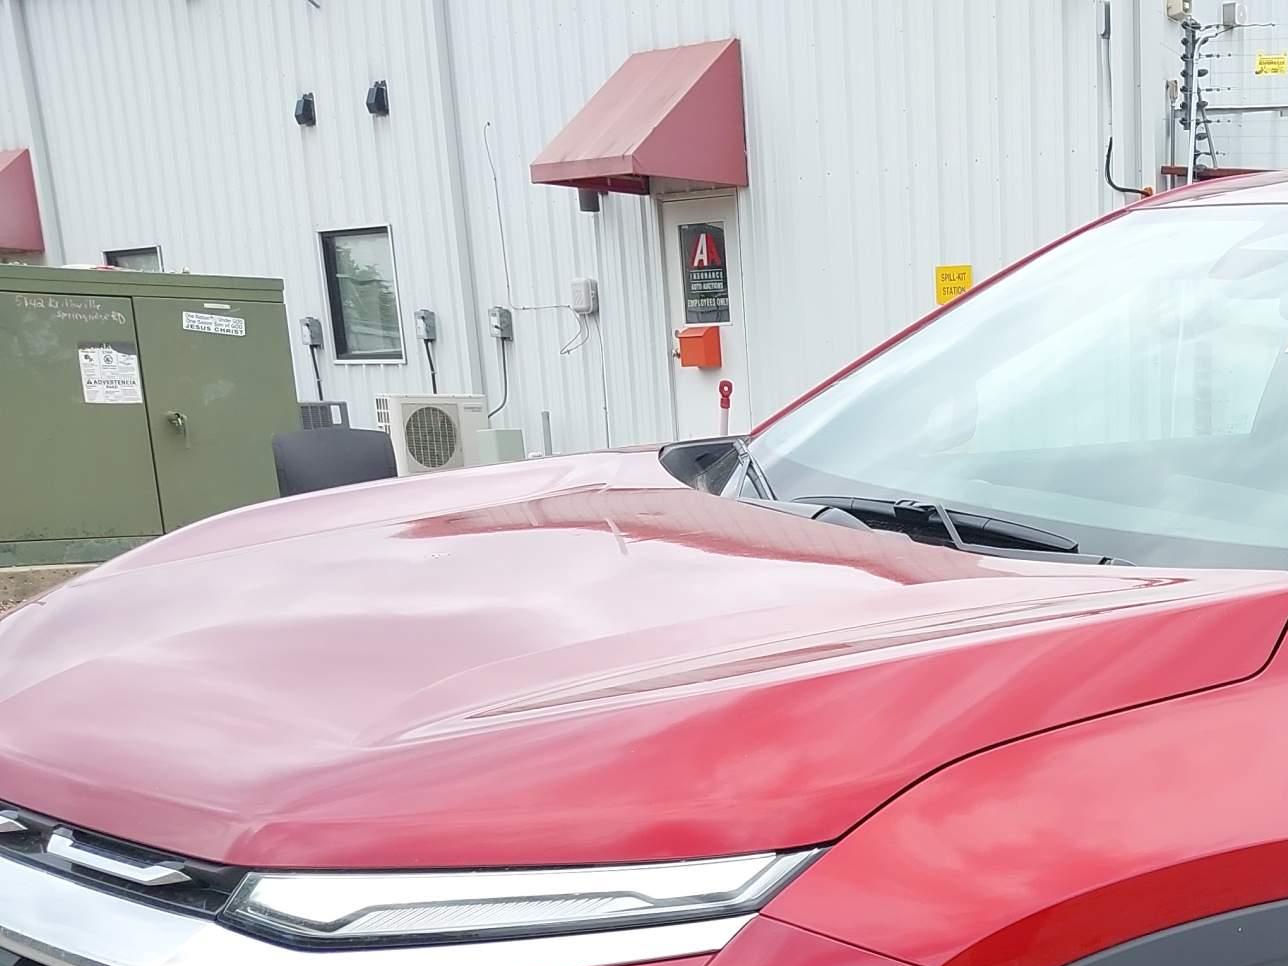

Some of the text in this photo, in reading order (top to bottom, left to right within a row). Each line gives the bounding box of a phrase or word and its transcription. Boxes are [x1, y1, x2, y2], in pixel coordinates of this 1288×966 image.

[689, 271, 723, 281] INSURANCE
[940, 272, 966, 281] SPILL-KIT
[688, 299, 715, 308] EMPLOYEES
[185, 324, 244, 335] JESUS CHRIST
